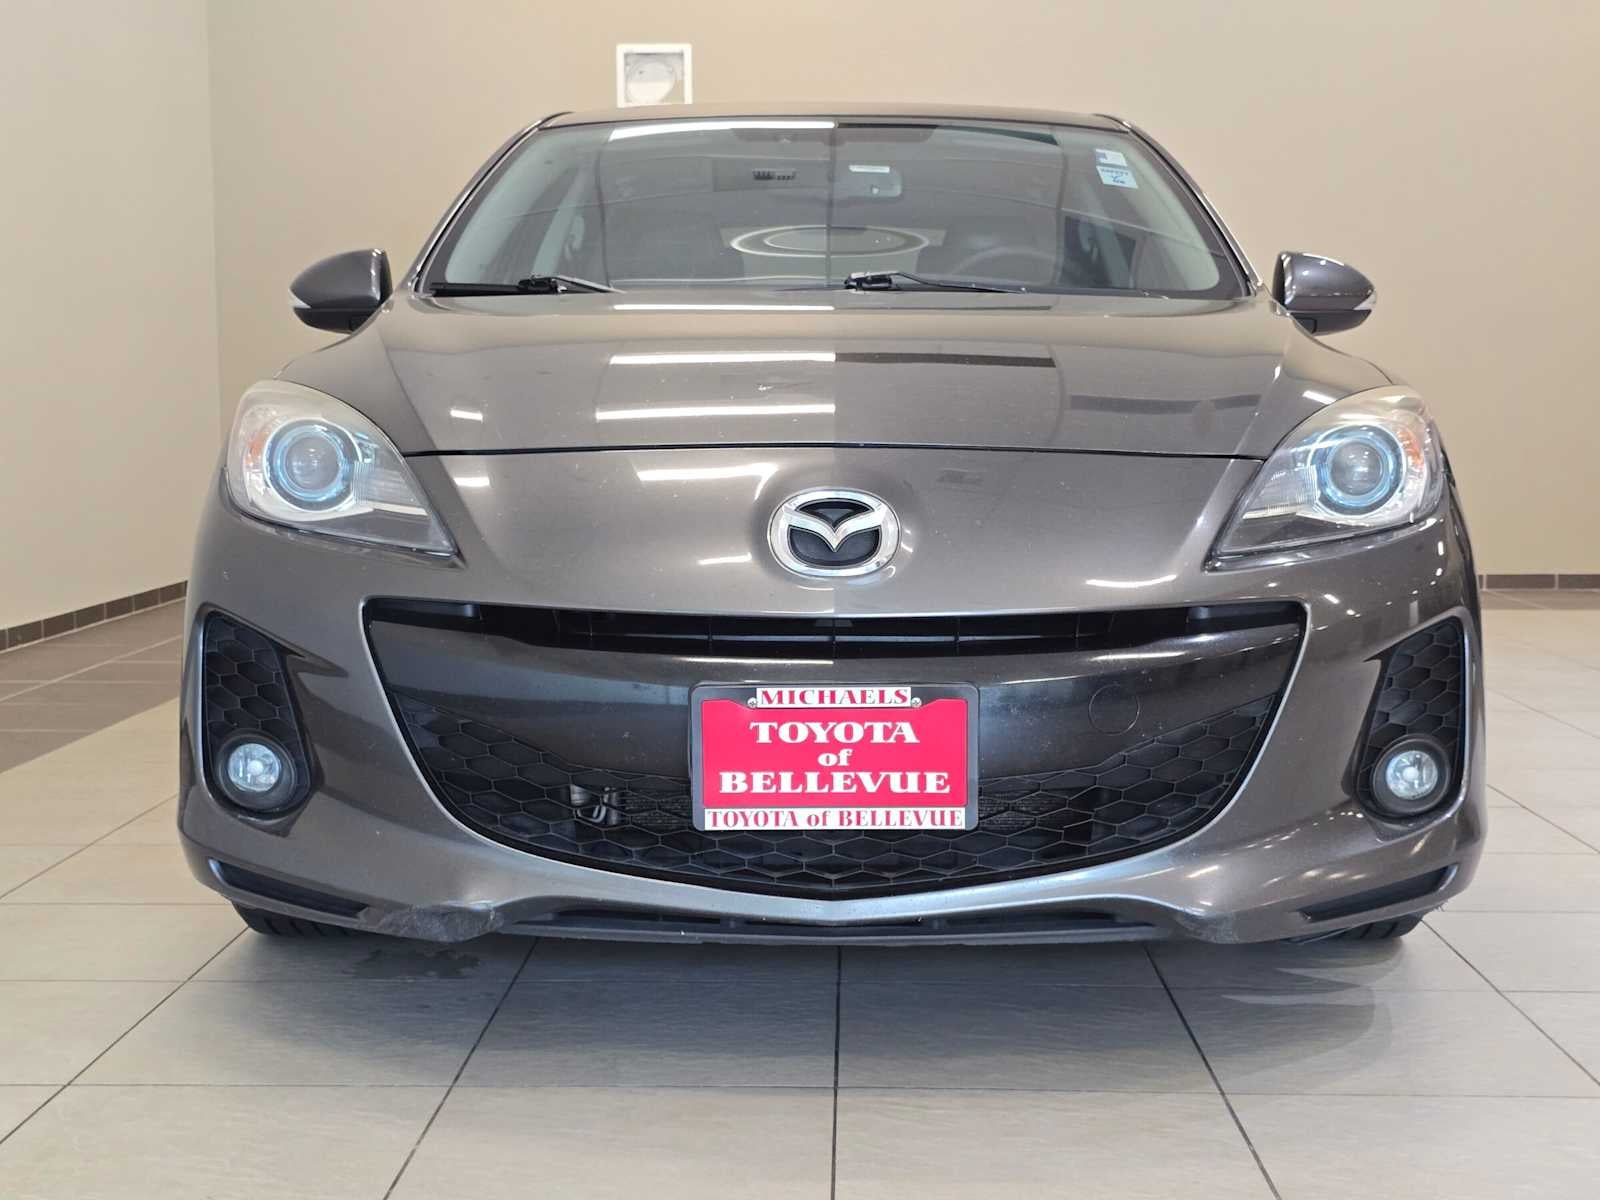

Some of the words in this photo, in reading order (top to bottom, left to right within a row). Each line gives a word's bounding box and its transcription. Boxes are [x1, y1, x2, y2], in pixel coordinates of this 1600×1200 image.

[761, 689, 908, 705] MICHAELS
[750, 721, 920, 743] TOYOTA
[818, 749, 853, 766] of
[719, 771, 950, 793] BELLEVUE
[707, 810, 798, 828] TOYOTA
[807, 810, 831, 826] of
[839, 810, 963, 827] BELLEVUE
